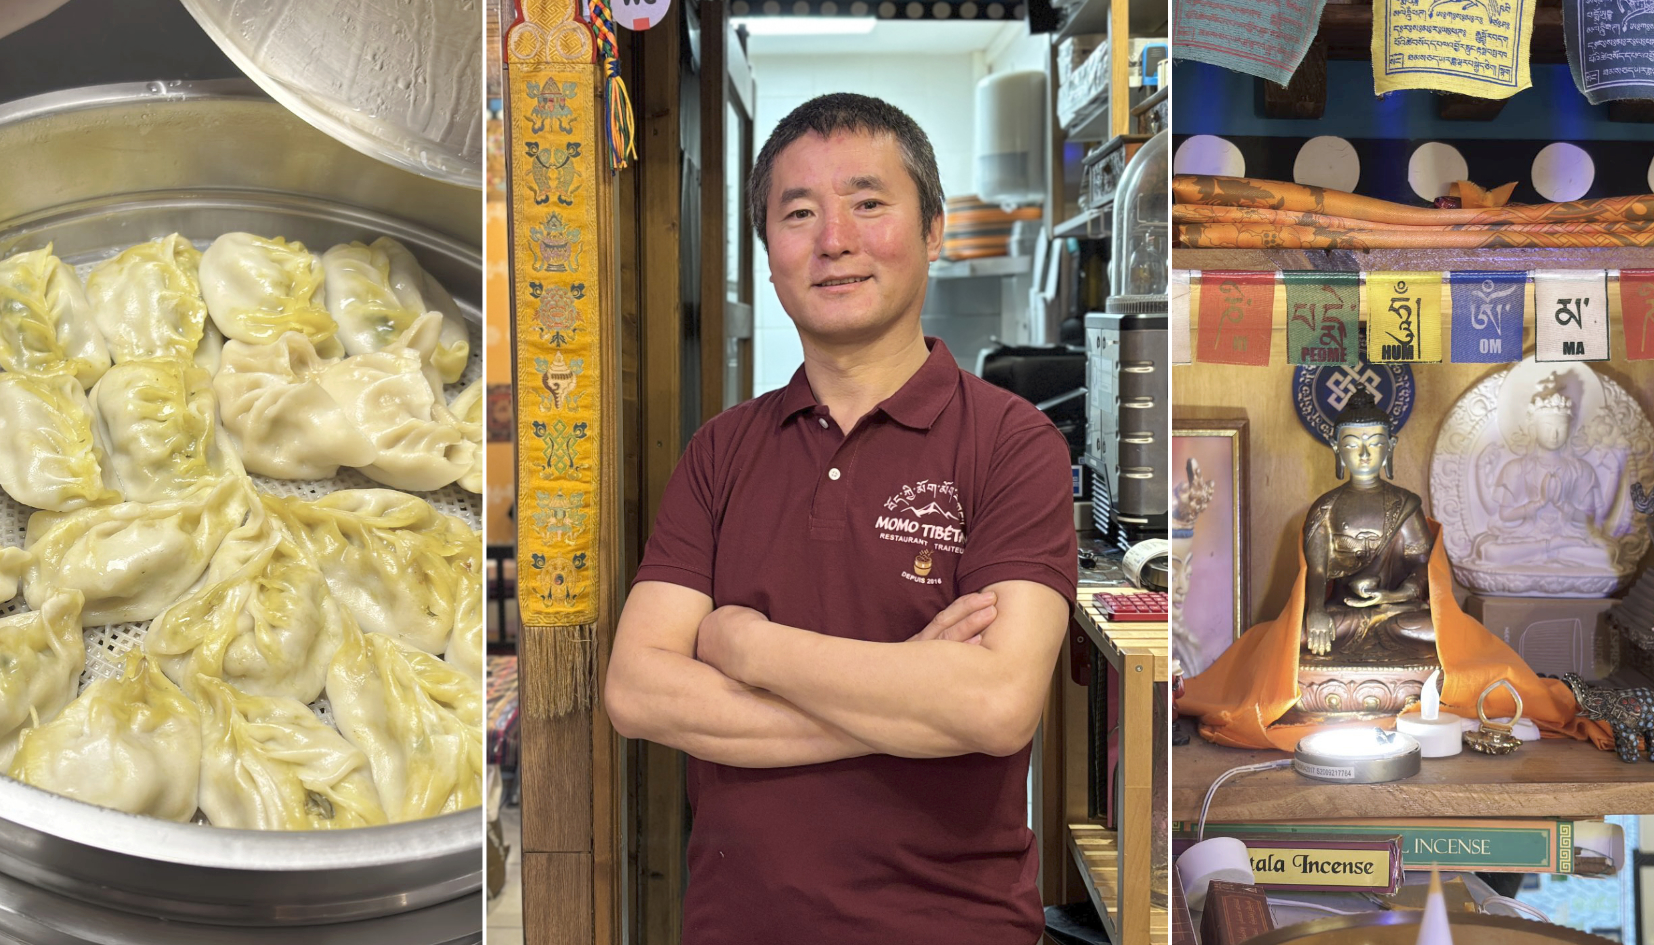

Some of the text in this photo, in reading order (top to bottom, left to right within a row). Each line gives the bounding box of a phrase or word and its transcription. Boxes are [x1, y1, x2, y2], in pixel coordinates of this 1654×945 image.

[1381, 344, 1414, 360] HUM
[1479, 338, 1502, 354] OM
[1562, 341, 1585, 355] MA
[875, 515, 967, 544] MOMO TIBÉTA
[879, 532, 929, 546] RESTAURANT
[901, 571, 926, 584] DEPUIS
[1414, 837, 1491, 855] INCENSE
[1292, 854, 1374, 875] Incense
